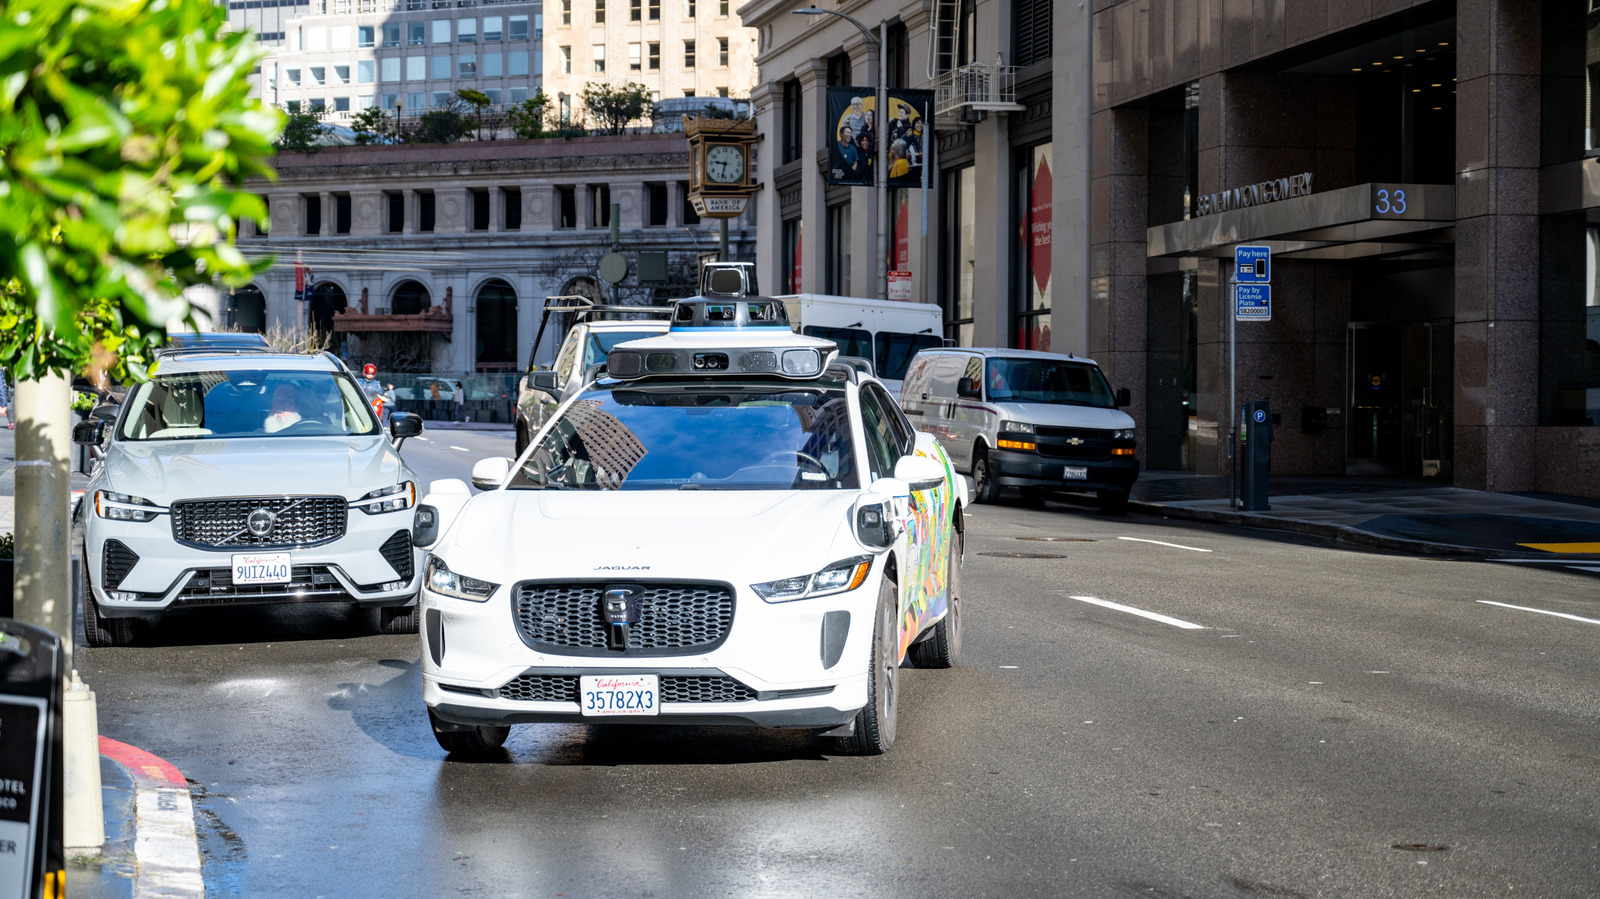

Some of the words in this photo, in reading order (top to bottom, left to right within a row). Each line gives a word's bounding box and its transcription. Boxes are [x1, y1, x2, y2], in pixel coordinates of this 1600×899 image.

[1234, 172, 1314, 208] MONTGOMERY
[1376, 189, 1406, 214] 33
[1238, 250, 1251, 258] Pay
[1257, 412, 1263, 420] P
[245, 556, 279, 565] California
[237, 564, 287, 579] 9UIZ440
[597, 679, 644, 690] California
[586, 691, 653, 709] 35782X3
